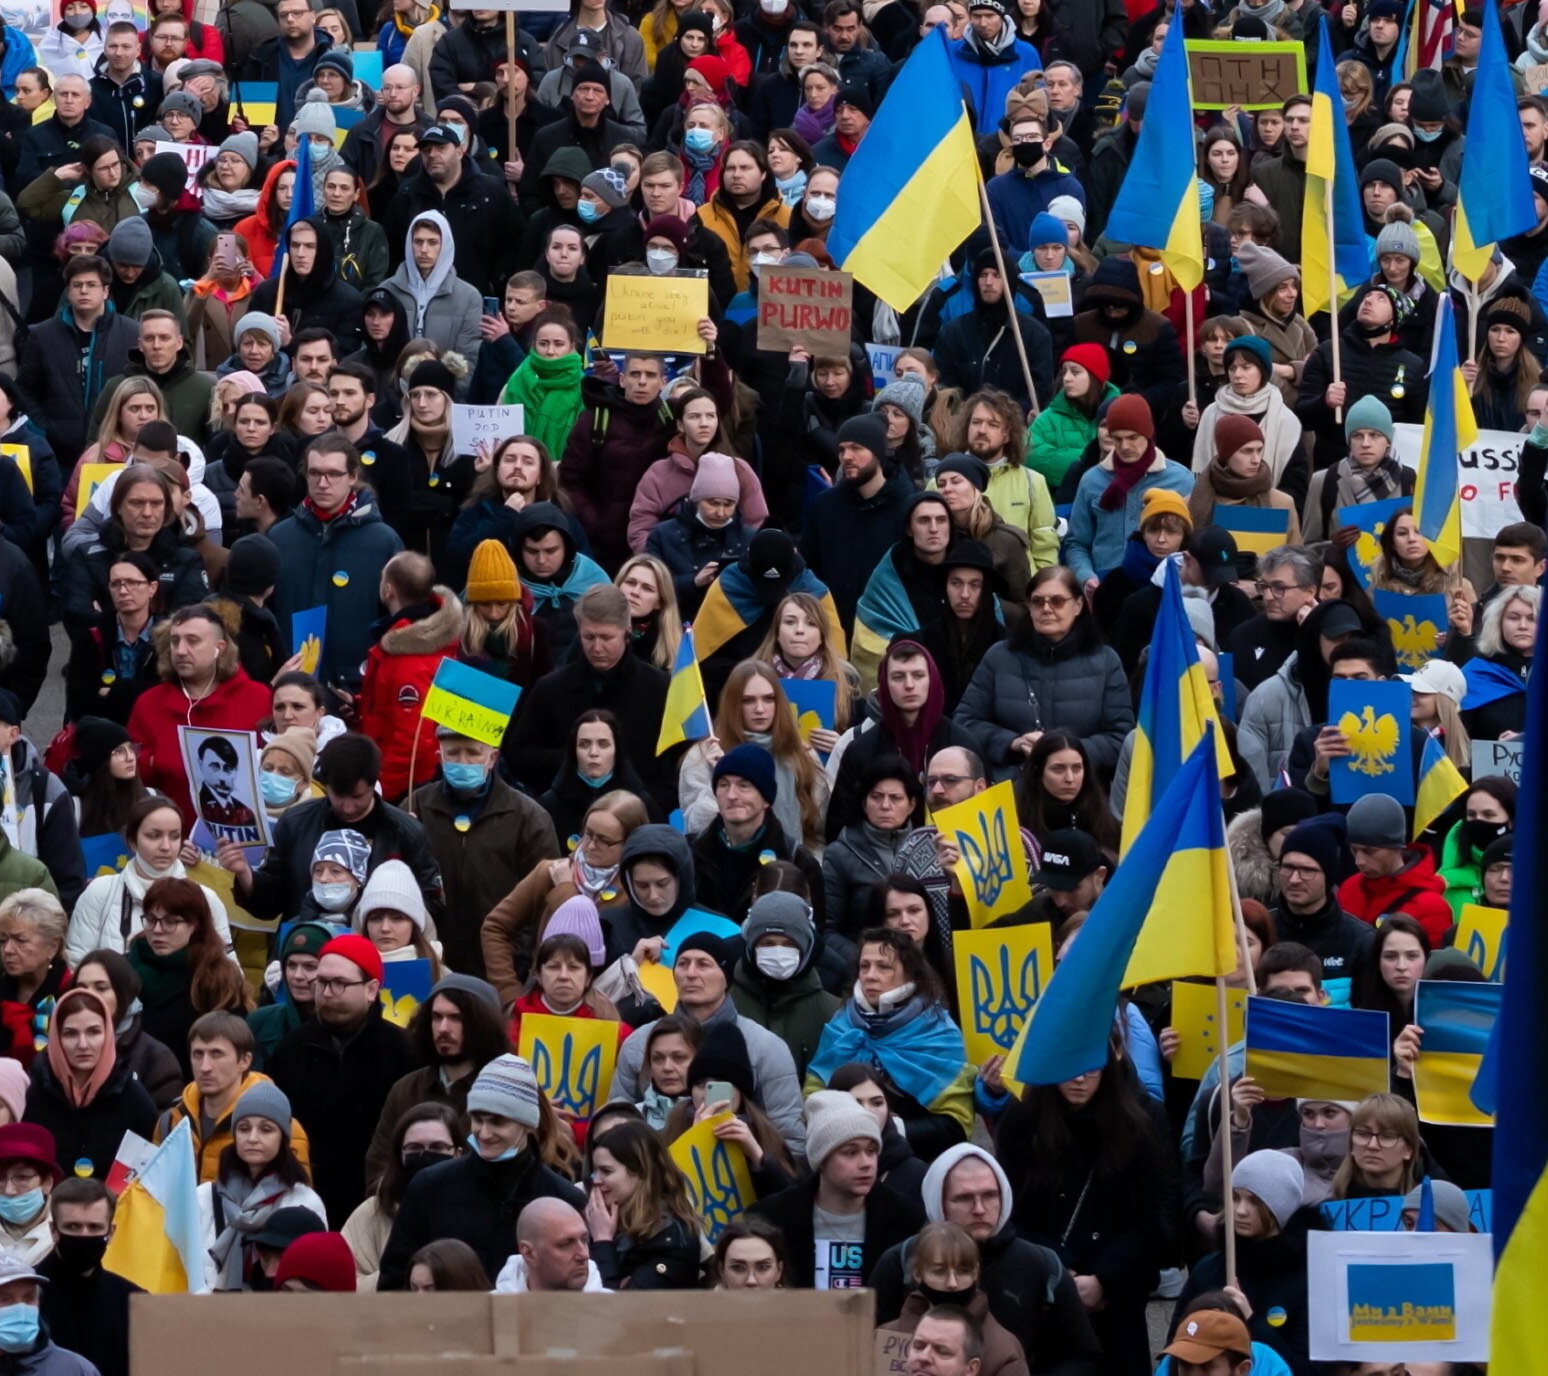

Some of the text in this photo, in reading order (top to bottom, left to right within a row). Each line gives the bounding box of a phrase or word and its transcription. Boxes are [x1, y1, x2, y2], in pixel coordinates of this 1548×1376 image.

[767, 275, 845, 299] KUTIN
[761, 301, 851, 333] PURWO
[831, 1244, 864, 1270] US
